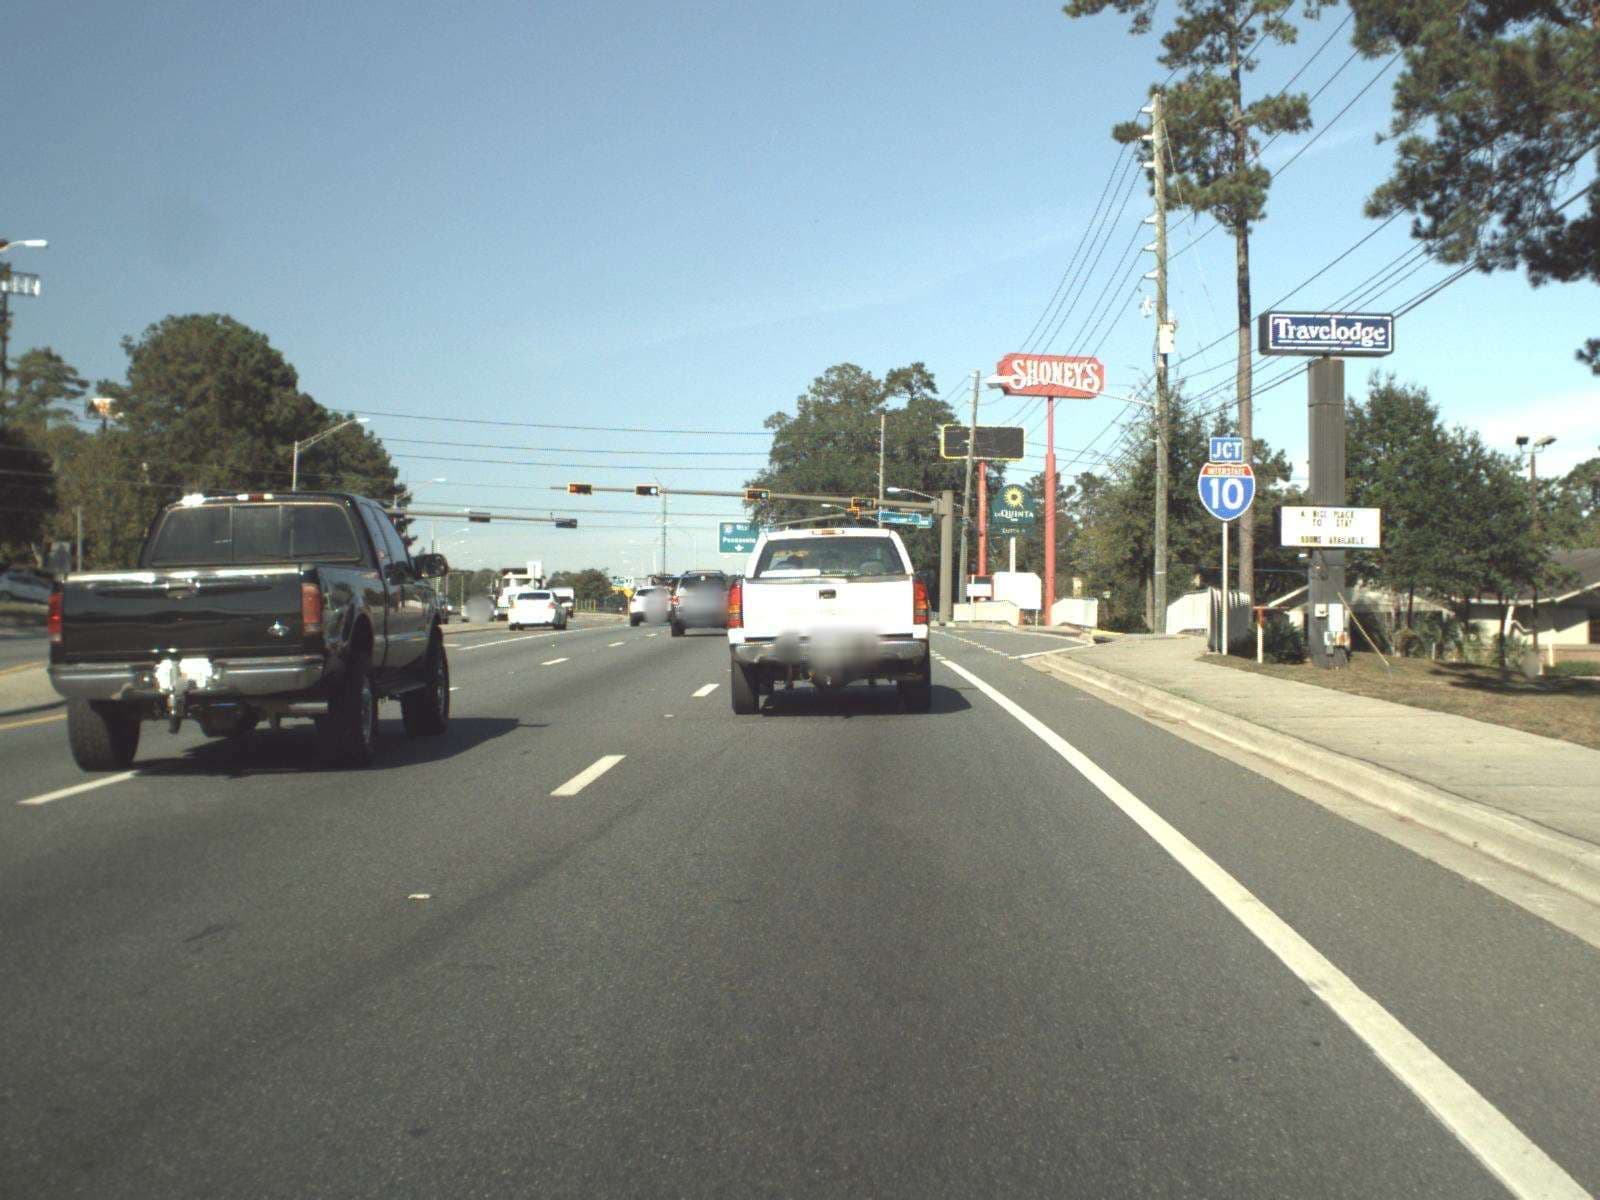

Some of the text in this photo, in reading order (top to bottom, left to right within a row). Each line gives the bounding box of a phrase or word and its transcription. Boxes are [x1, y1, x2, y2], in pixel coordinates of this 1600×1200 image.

[1274, 318, 1386, 347] Travelodge
[1009, 359, 1101, 393] SHONEY'S
[1212, 441, 1242, 459] JCT
[1209, 478, 1244, 510] 10
[1001, 509, 1034, 519] QUINTA
